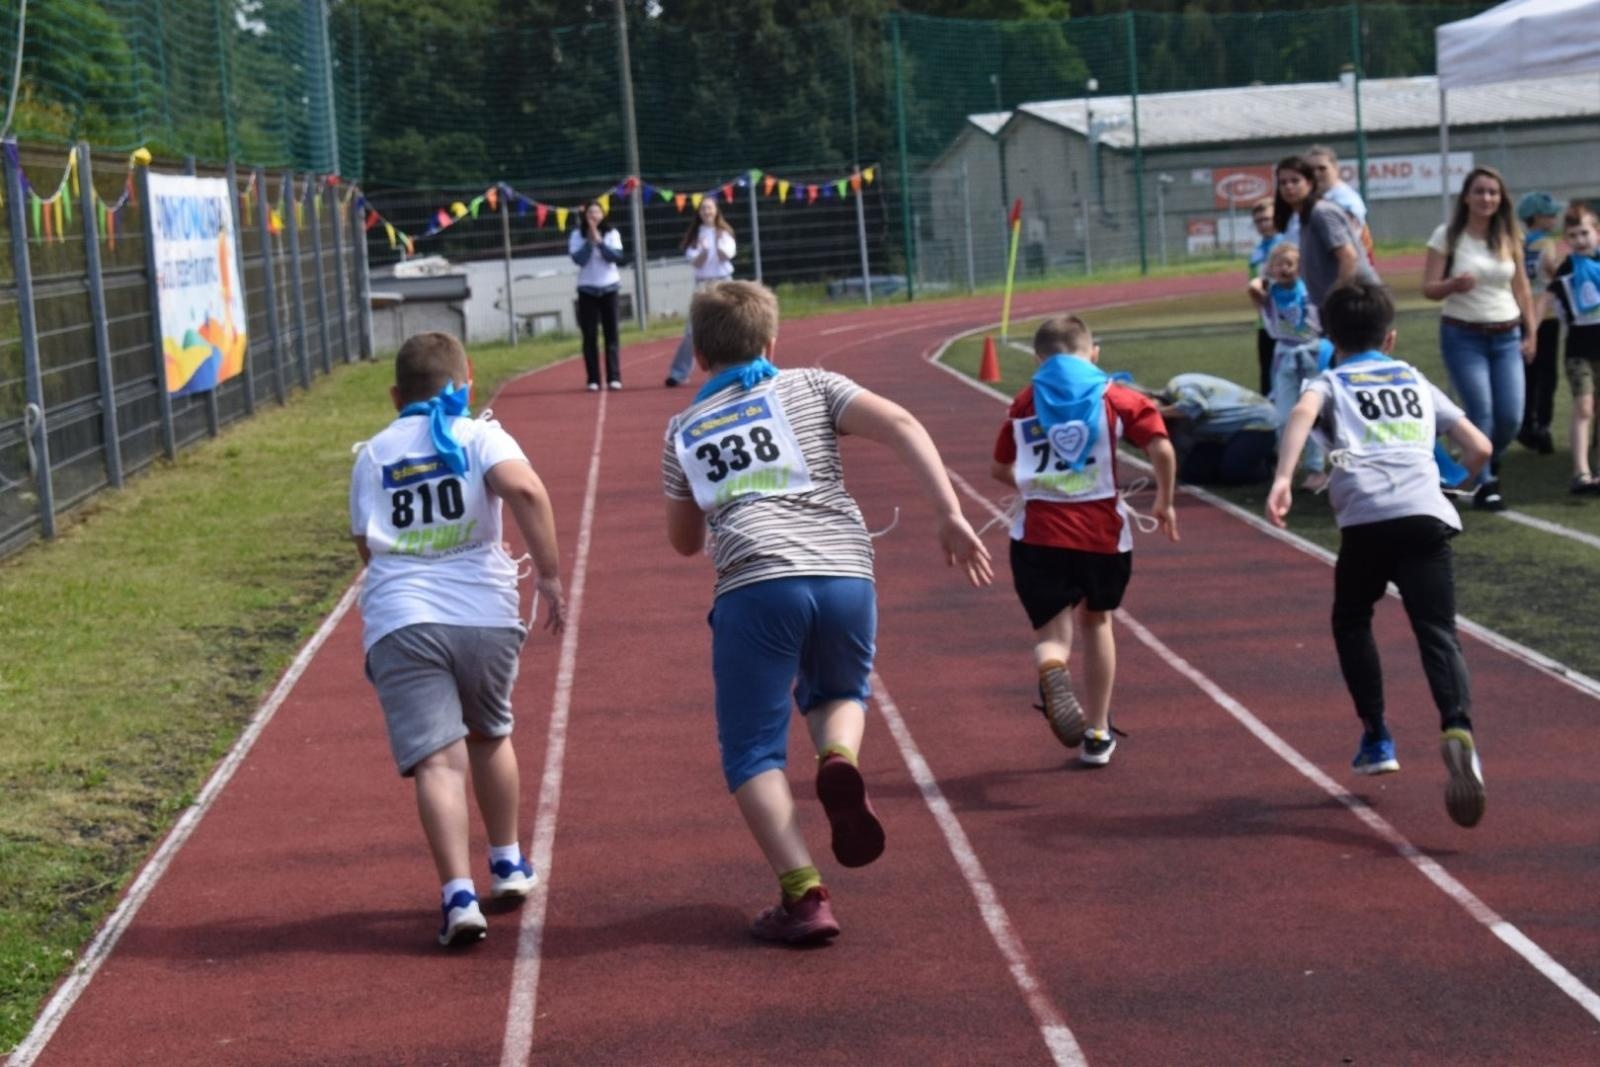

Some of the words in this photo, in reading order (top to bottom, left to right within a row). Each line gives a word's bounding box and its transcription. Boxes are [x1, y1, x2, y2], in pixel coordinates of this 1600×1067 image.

[1356, 387, 1423, 420] 808
[696, 426, 780, 482] 338
[392, 477, 465, 529] 810
